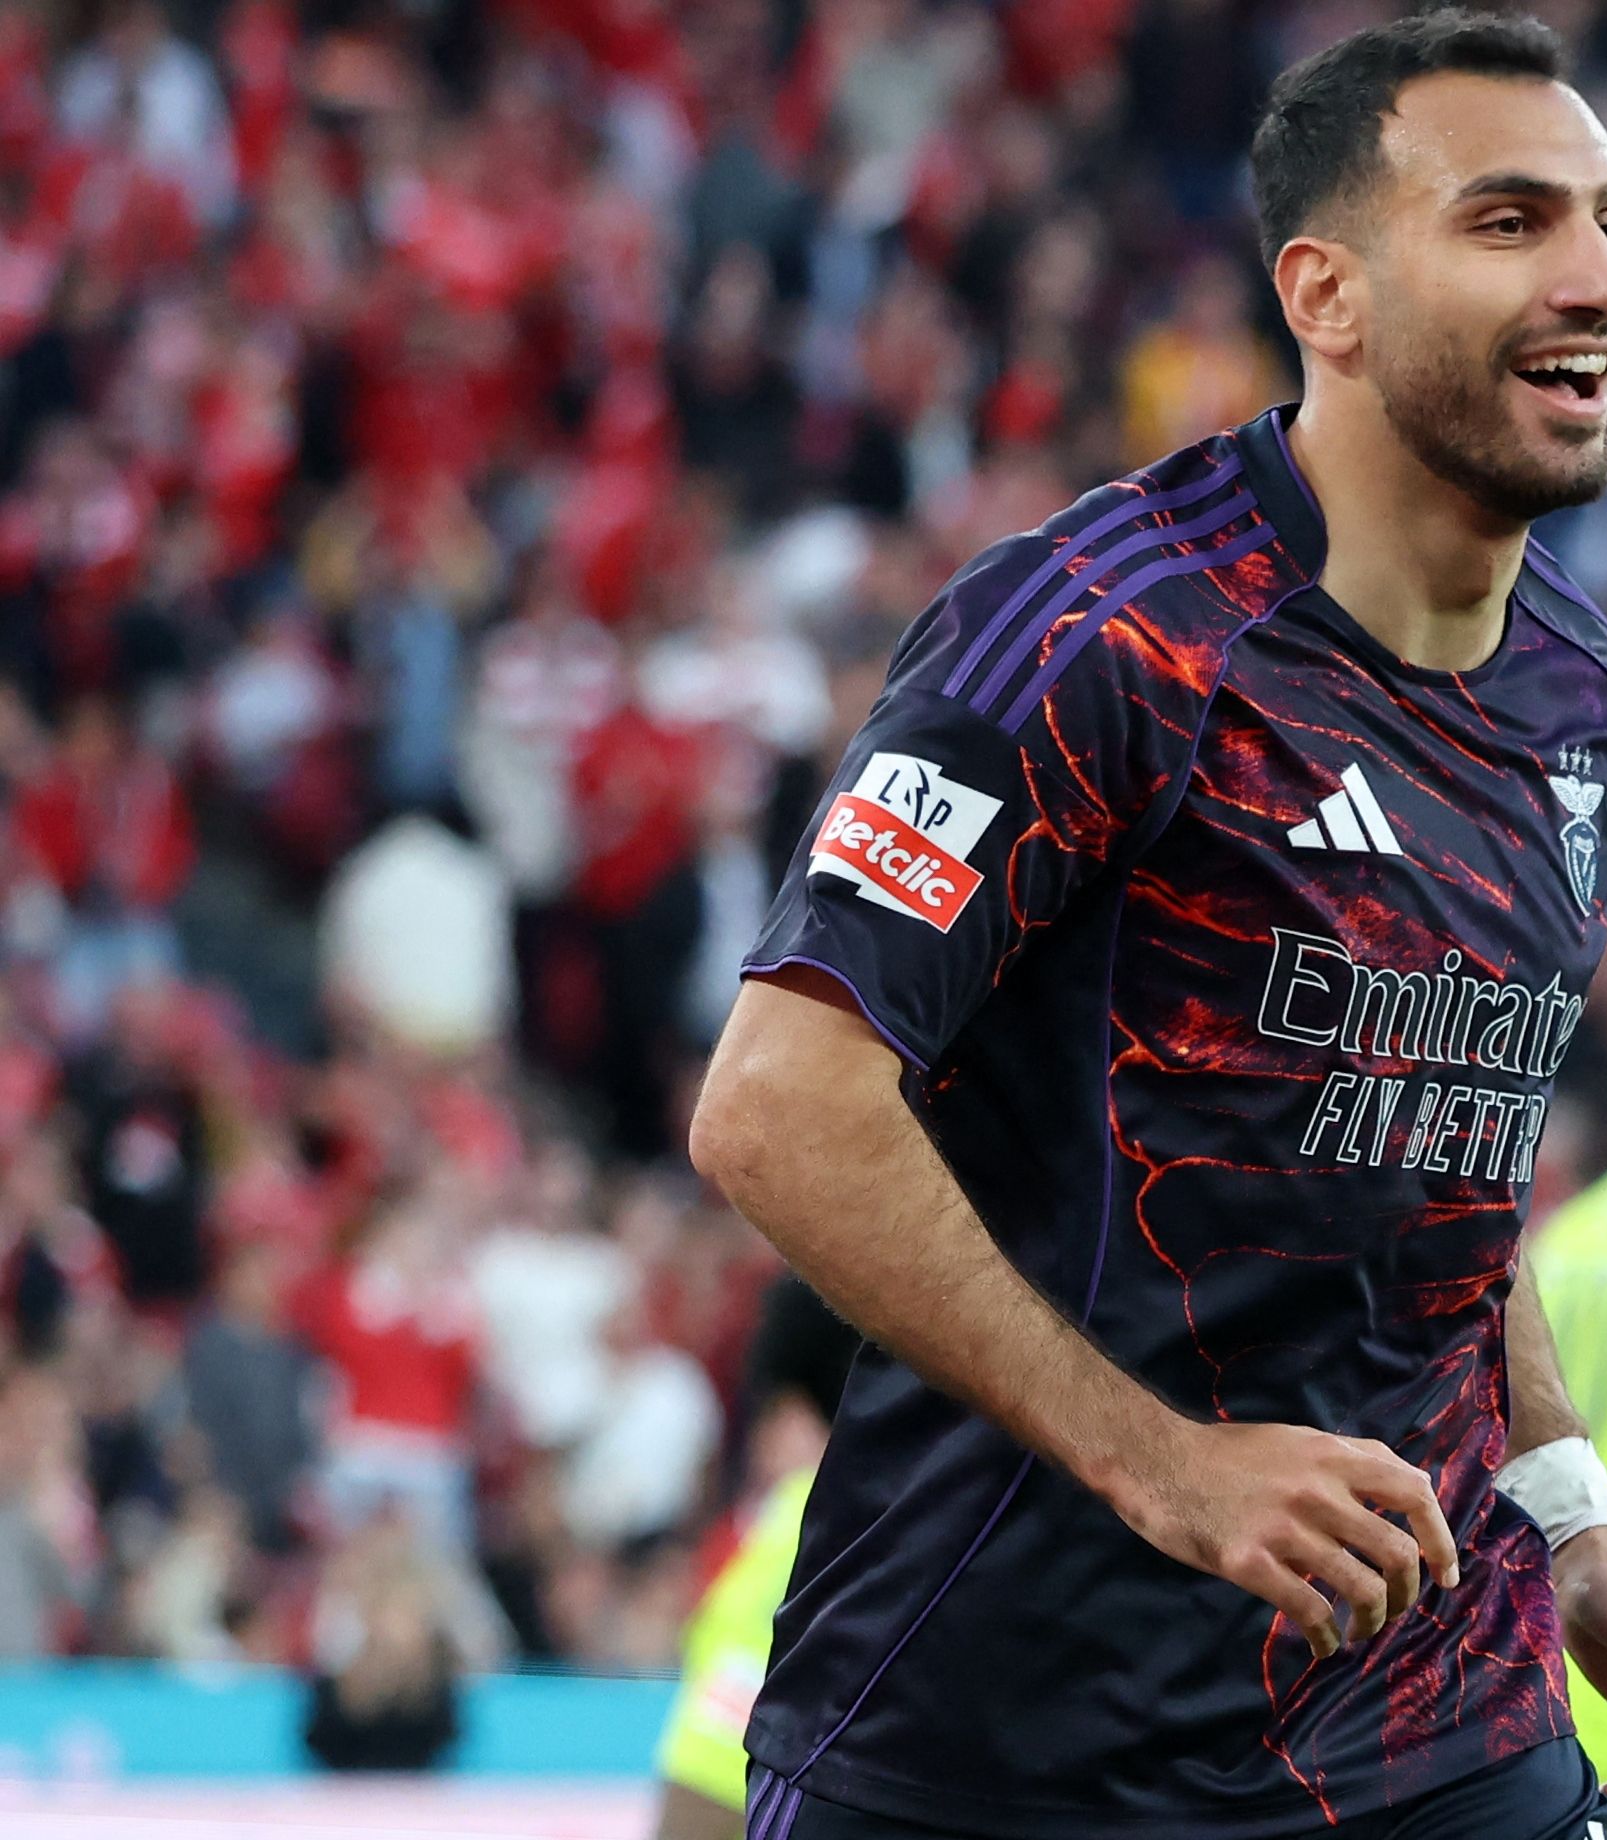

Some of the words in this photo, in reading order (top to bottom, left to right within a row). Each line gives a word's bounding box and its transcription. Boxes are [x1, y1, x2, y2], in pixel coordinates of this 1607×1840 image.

[823, 806, 956, 908] Betclic
[1258, 926, 1588, 1078] Emirate
[1299, 1071, 1405, 1167] FLY
